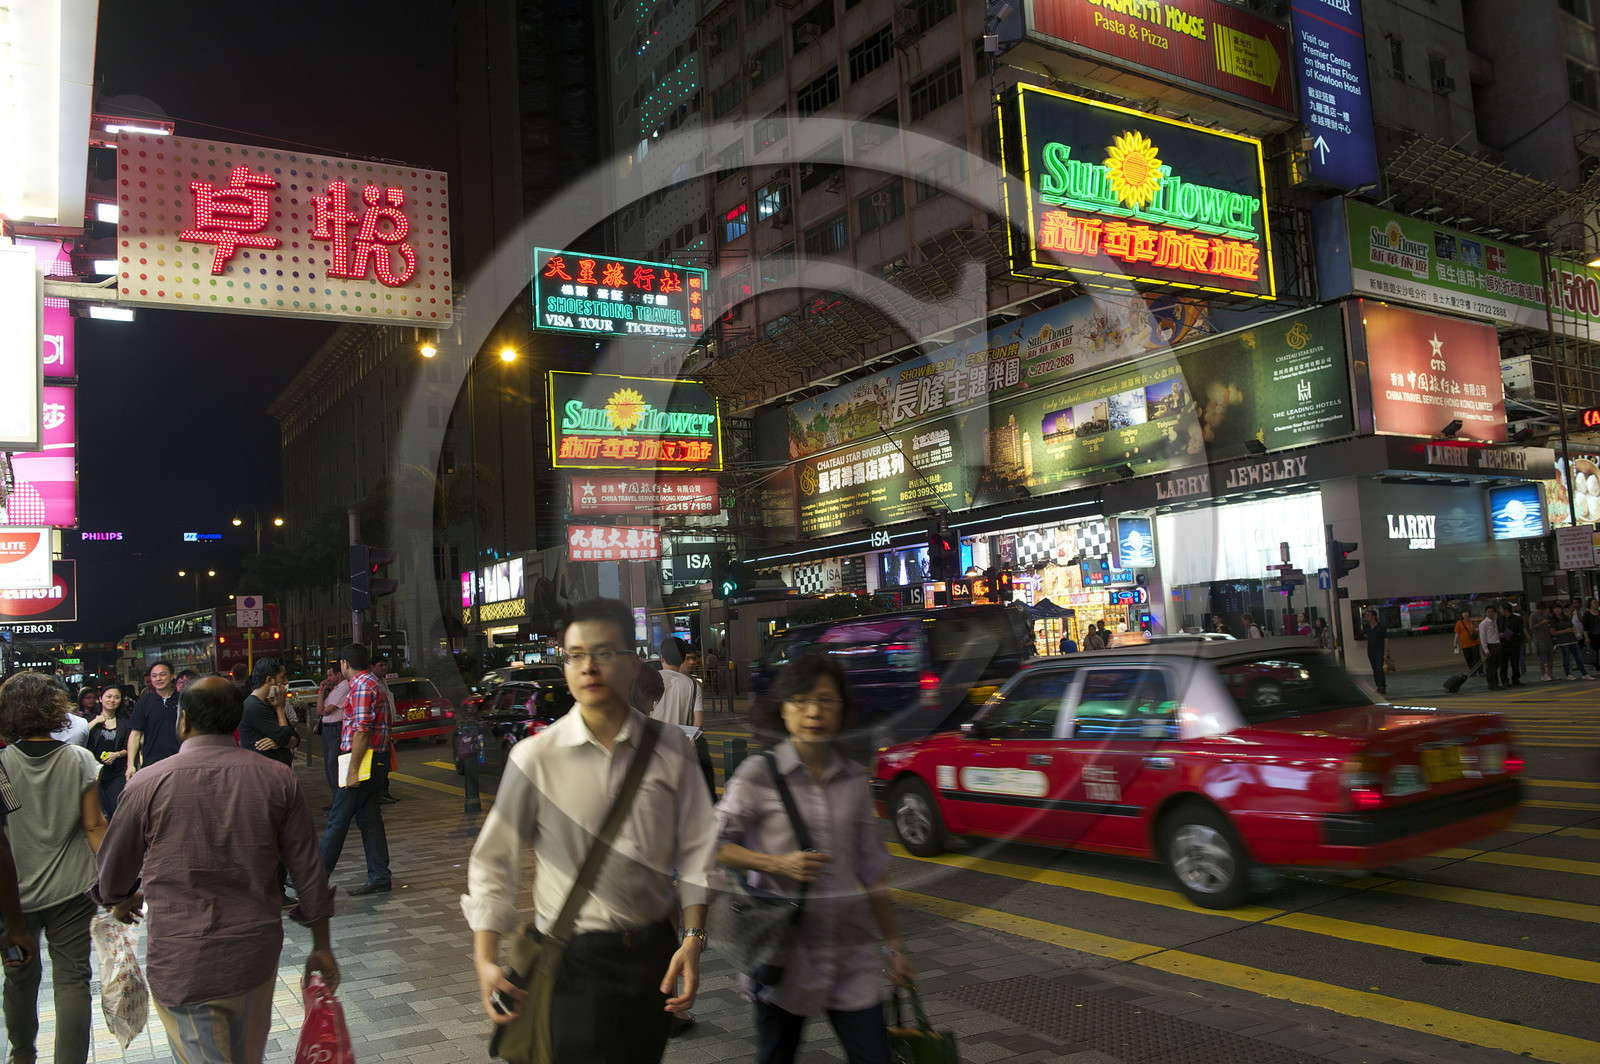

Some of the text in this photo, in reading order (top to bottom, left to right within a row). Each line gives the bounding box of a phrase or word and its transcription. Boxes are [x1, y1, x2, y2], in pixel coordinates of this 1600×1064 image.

[1094, 11, 1168, 49] Pasta & Pizza
[1165, 4, 1206, 41] HOUSE
[1301, 30, 1329, 49] Visit our
[1302, 42, 1351, 70] Premier Centre
[1304, 57, 1359, 83] on the First Floor
[1305, 68, 1361, 96] of Kowloon Hotel
[547, 296, 684, 325] SHOESTRING TRAVEL
[1477, 302, 1507, 318] 2722 2888
[545, 314, 687, 338] VISA TOUR TICKETING
[1037, 353, 1074, 375] 2722 2888
[1275, 353, 1297, 363] CHATEAU
[1297, 349, 1309, 357] STAR
[1309, 345, 1324, 353] RIVER
[1430, 359, 1446, 371] CTS
[891, 356, 1021, 423] 長隆主題樂園
[1390, 373, 1404, 387] 香港
[1463, 383, 1487, 398] 有限公司
[1272, 399, 1341, 419] THE LEADING HOTELS
[1386, 390, 1493, 411] CHINA TRAVEL SERVICE (HONG KONG) LIMITED
[816, 453, 845, 471] CHATEAU
[845, 450, 862, 463] STAR
[862, 445, 882, 459] RIVER
[882, 439, 903, 454] SERIES
[1424, 445, 1528, 471] LARRY JEWELRY
[1156, 455, 1308, 501] LARRY JEWELRY
[601, 485, 614, 493] 香港
[676, 485, 701, 493] 有限公司
[899, 490, 917, 501] 8620
[934, 481, 953, 493] 3628
[666, 503, 688, 511] 2315
[81, 532, 123, 541] PHILIPS
[1387, 514, 1436, 539] LARRY
[871, 530, 890, 548] ISA
[1408, 538, 1436, 549] JEWELRY
[687, 554, 712, 569] ISA
[827, 568, 840, 581] ISA
[910, 588, 924, 604] IS
[952, 584, 969, 595] ISA
